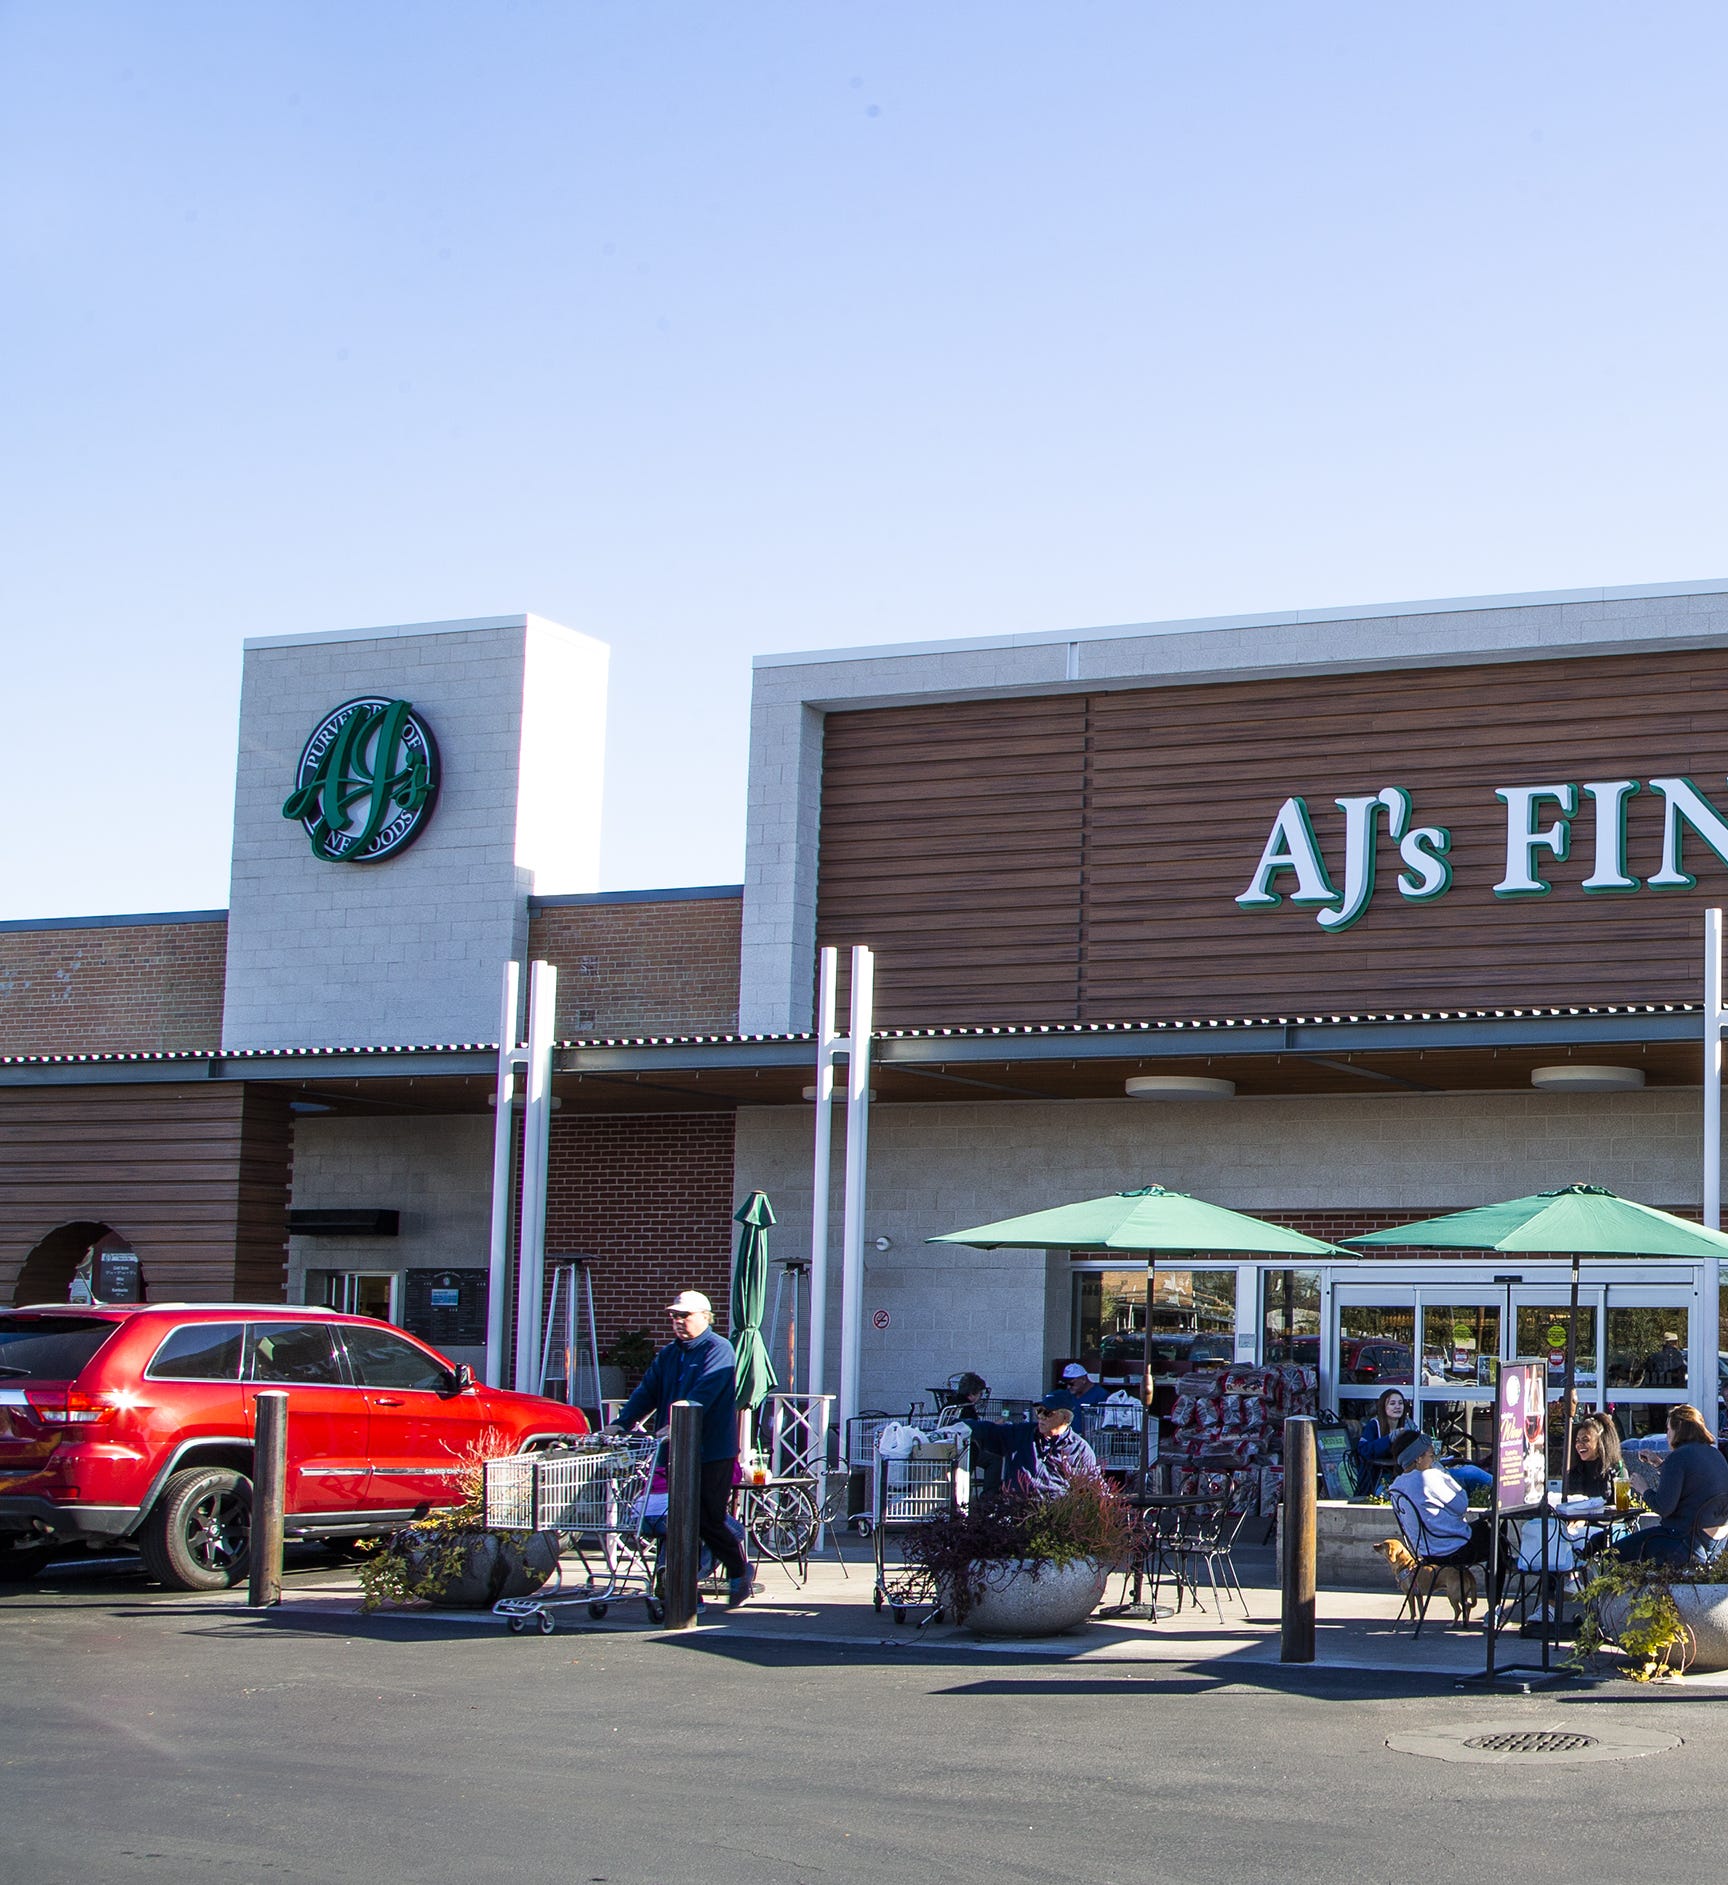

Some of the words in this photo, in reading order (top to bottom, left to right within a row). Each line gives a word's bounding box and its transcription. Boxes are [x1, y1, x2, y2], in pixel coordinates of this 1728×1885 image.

[402, 724, 422, 749] OF
[368, 809, 413, 852] OODS
[1235, 786, 1452, 932] AJ's
